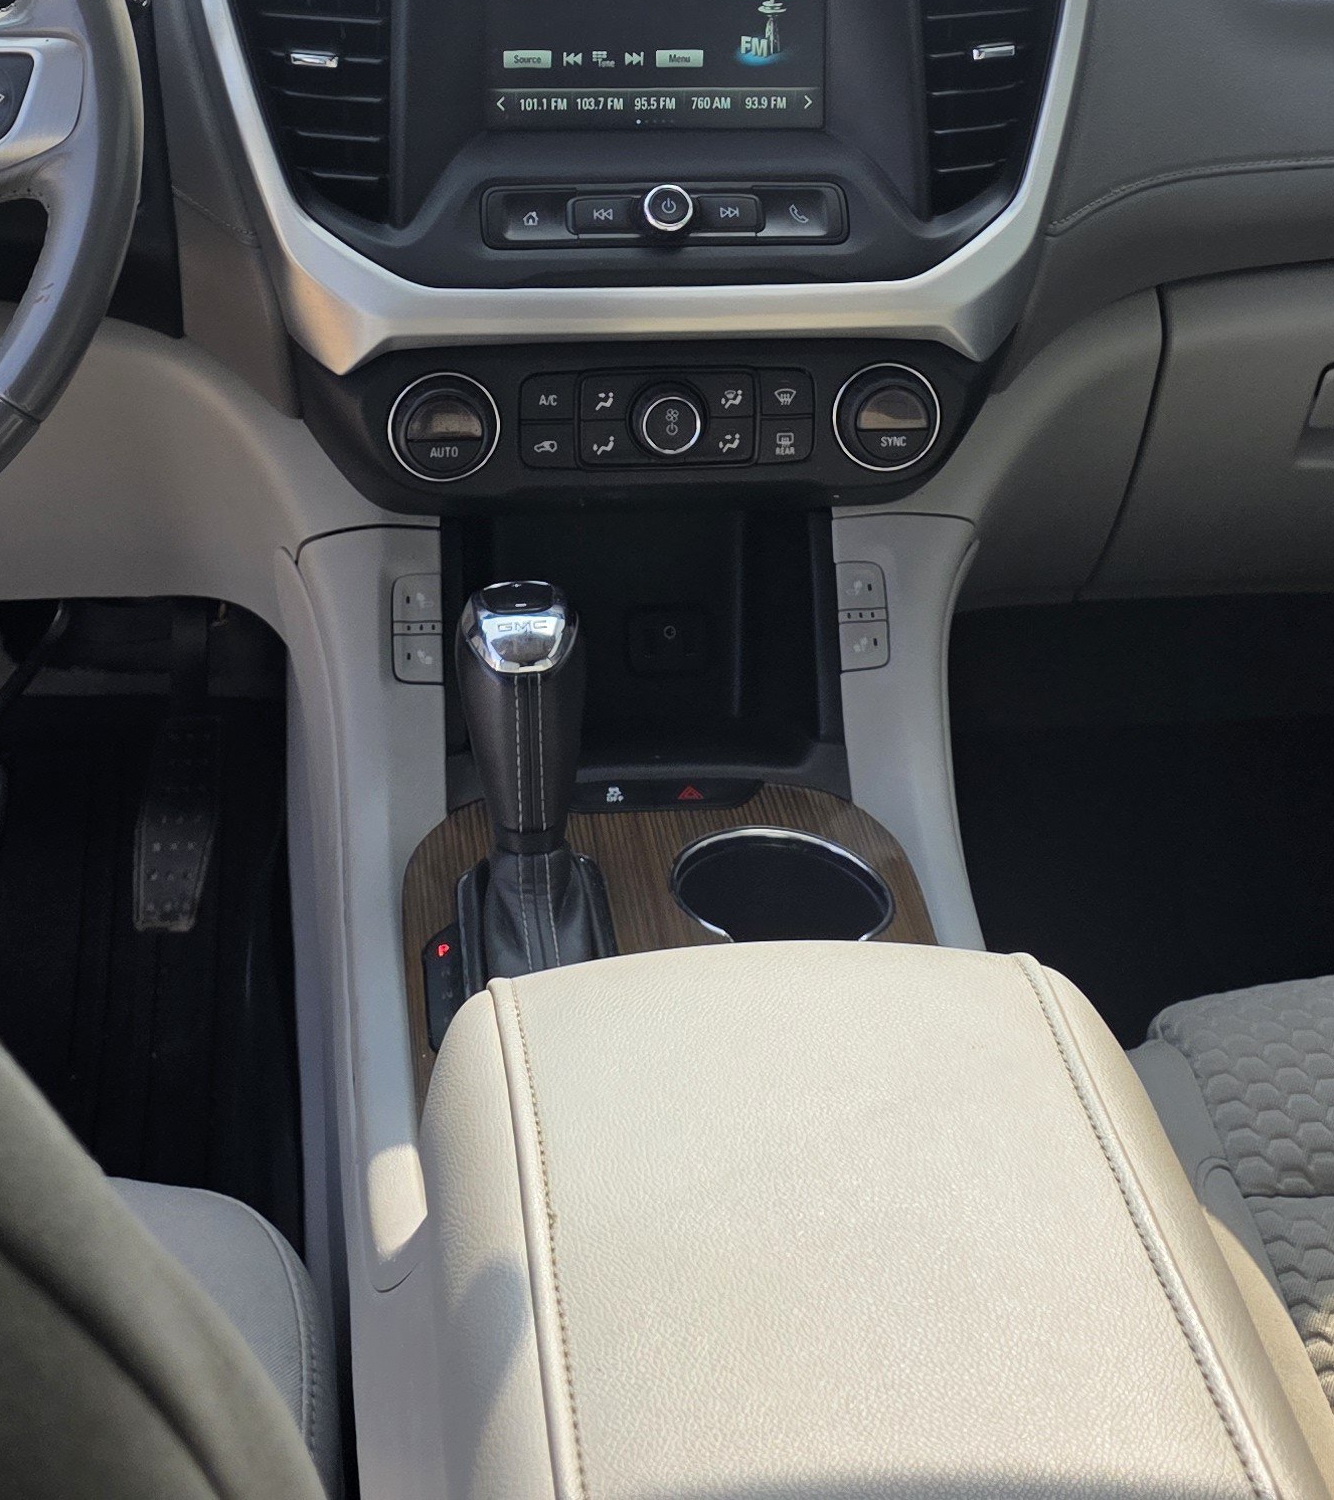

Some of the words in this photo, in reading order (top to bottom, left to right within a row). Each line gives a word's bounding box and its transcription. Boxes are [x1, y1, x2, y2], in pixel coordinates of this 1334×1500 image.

[740, 35, 768, 57] FM
[513, 53, 542, 65] Source
[668, 53, 691, 64] Menu
[519, 98, 547, 111] 101.1
[551, 98, 567, 110] FM
[576, 97, 605, 110] 103.7
[607, 97, 624, 110] FM
[634, 97, 657, 110] 95.5
[659, 97, 676, 110] FM
[691, 97, 711, 110] 760
[712, 97, 731, 109] AM
[745, 96, 768, 110] 93.9
[770, 97, 787, 109] FM
[538, 394, 558, 407] A/C
[880, 436, 907, 448] SYNC
[429, 445, 459, 458] AUTO
[775, 447, 795, 456] REAR
[497, 619, 548, 633] GMC
[438, 943, 450, 957] P
